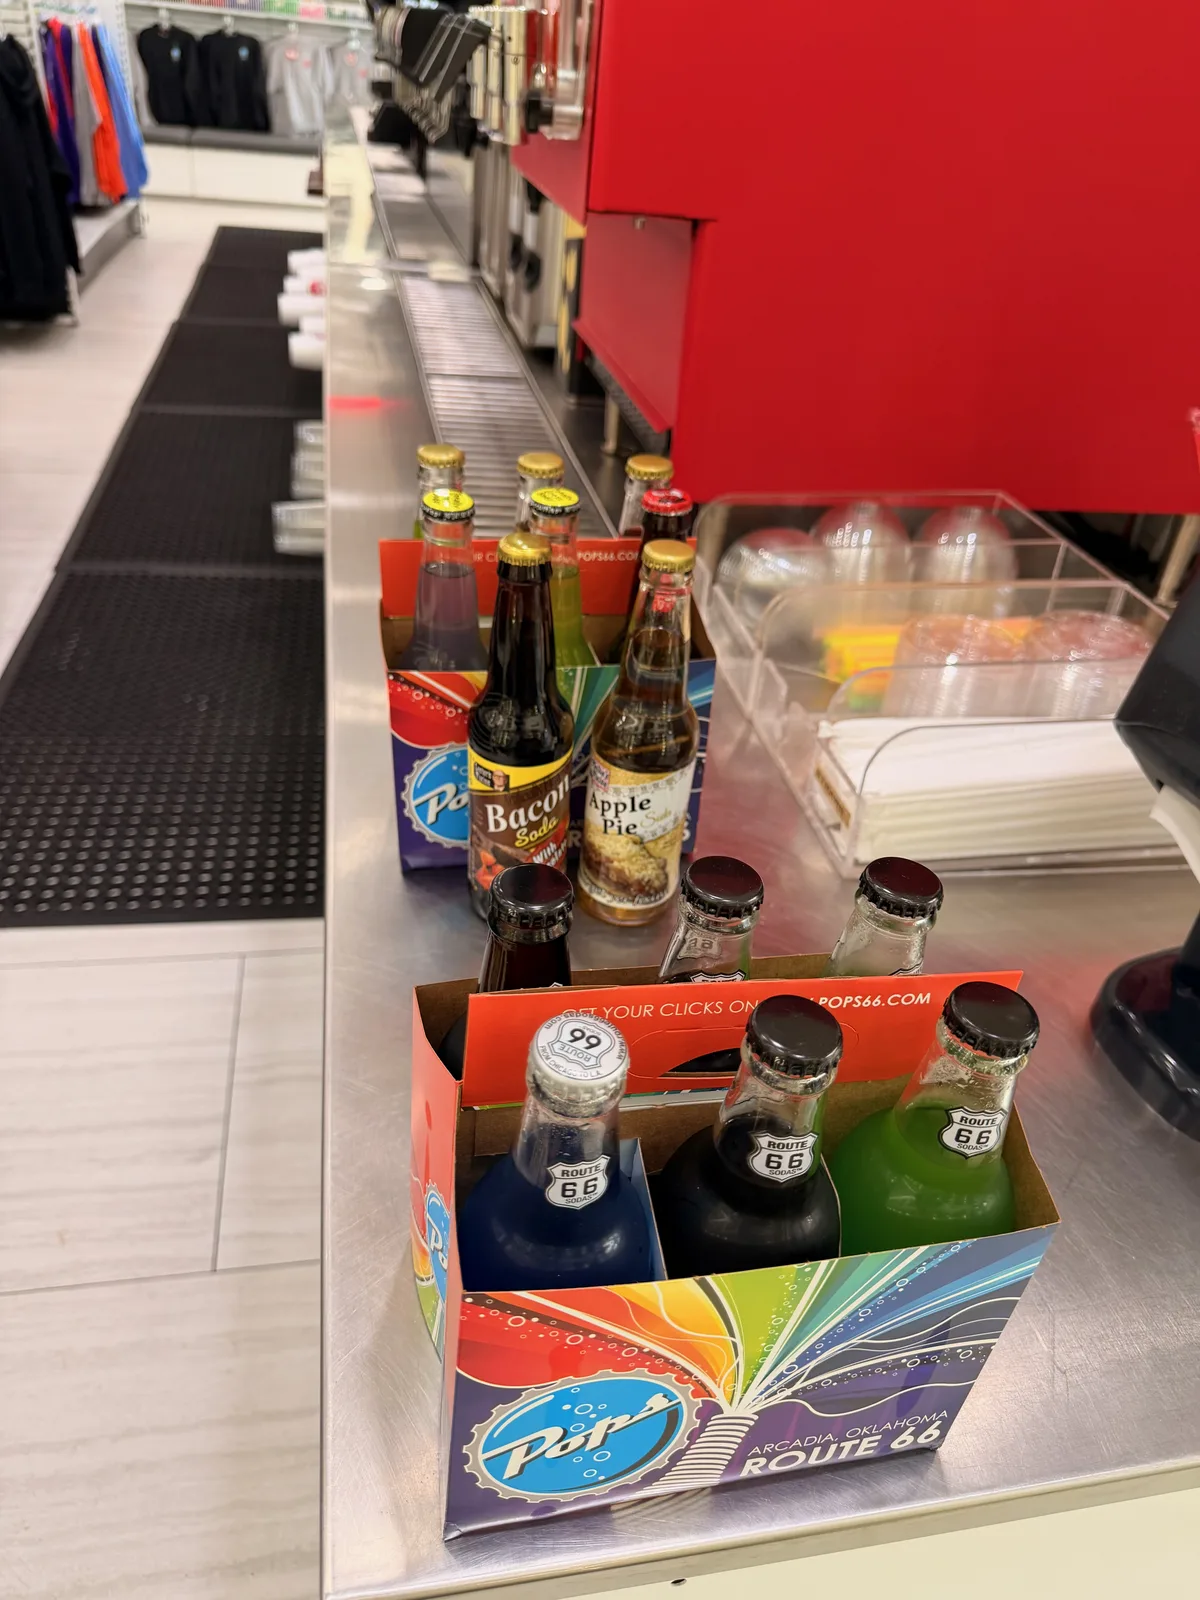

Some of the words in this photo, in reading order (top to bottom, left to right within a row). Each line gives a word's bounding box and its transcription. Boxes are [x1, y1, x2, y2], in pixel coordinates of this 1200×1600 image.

[412, 783, 469, 826] Po
[484, 774, 569, 833] Bacon
[589, 791, 651, 819] Apple
[515, 816, 559, 847] Soda
[602, 819, 637, 836] Pie
[602, 1003, 653, 1019] YOUR
[659, 1000, 723, 1017] CLICKS
[568, 1028, 601, 1050] 66
[559, 1043, 592, 1063] ROUTE
[960, 1115, 998, 1126] ROUTE
[767, 1140, 808, 1150] ROUTE
[955, 1128, 992, 1145] 66
[561, 1163, 601, 1177] ROUTE
[765, 1152, 804, 1170] 66
[561, 1177, 598, 1198] 66
[482, 1392, 681, 1480] Pops
[747, 1432, 839, 1457] ARCADIA,
[845, 1409, 949, 1438] OKLAHOMA
[739, 1434, 883, 1477] ROUTE
[889, 1420, 943, 1449] 66
